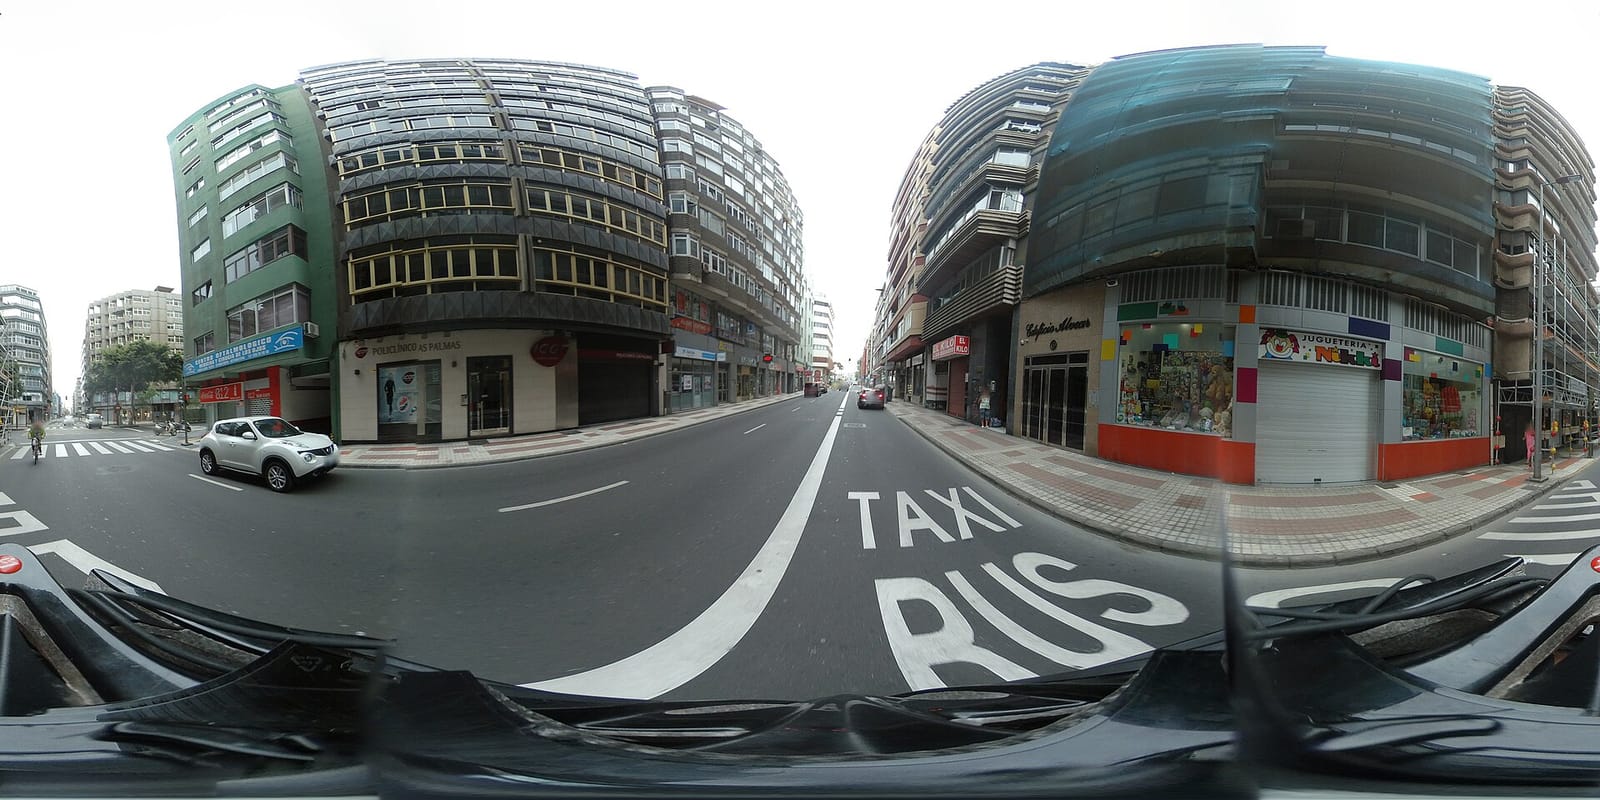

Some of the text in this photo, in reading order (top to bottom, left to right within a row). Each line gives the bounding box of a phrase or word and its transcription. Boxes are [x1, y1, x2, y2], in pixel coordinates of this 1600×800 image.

[428, 341, 461, 352] PALMAS
[1302, 335, 1367, 349] JUGUETERIA
[1315, 346, 1380, 368] Nikki
[848, 486, 1023, 549] TAXI
[874, 552, 1190, 692] BUS
